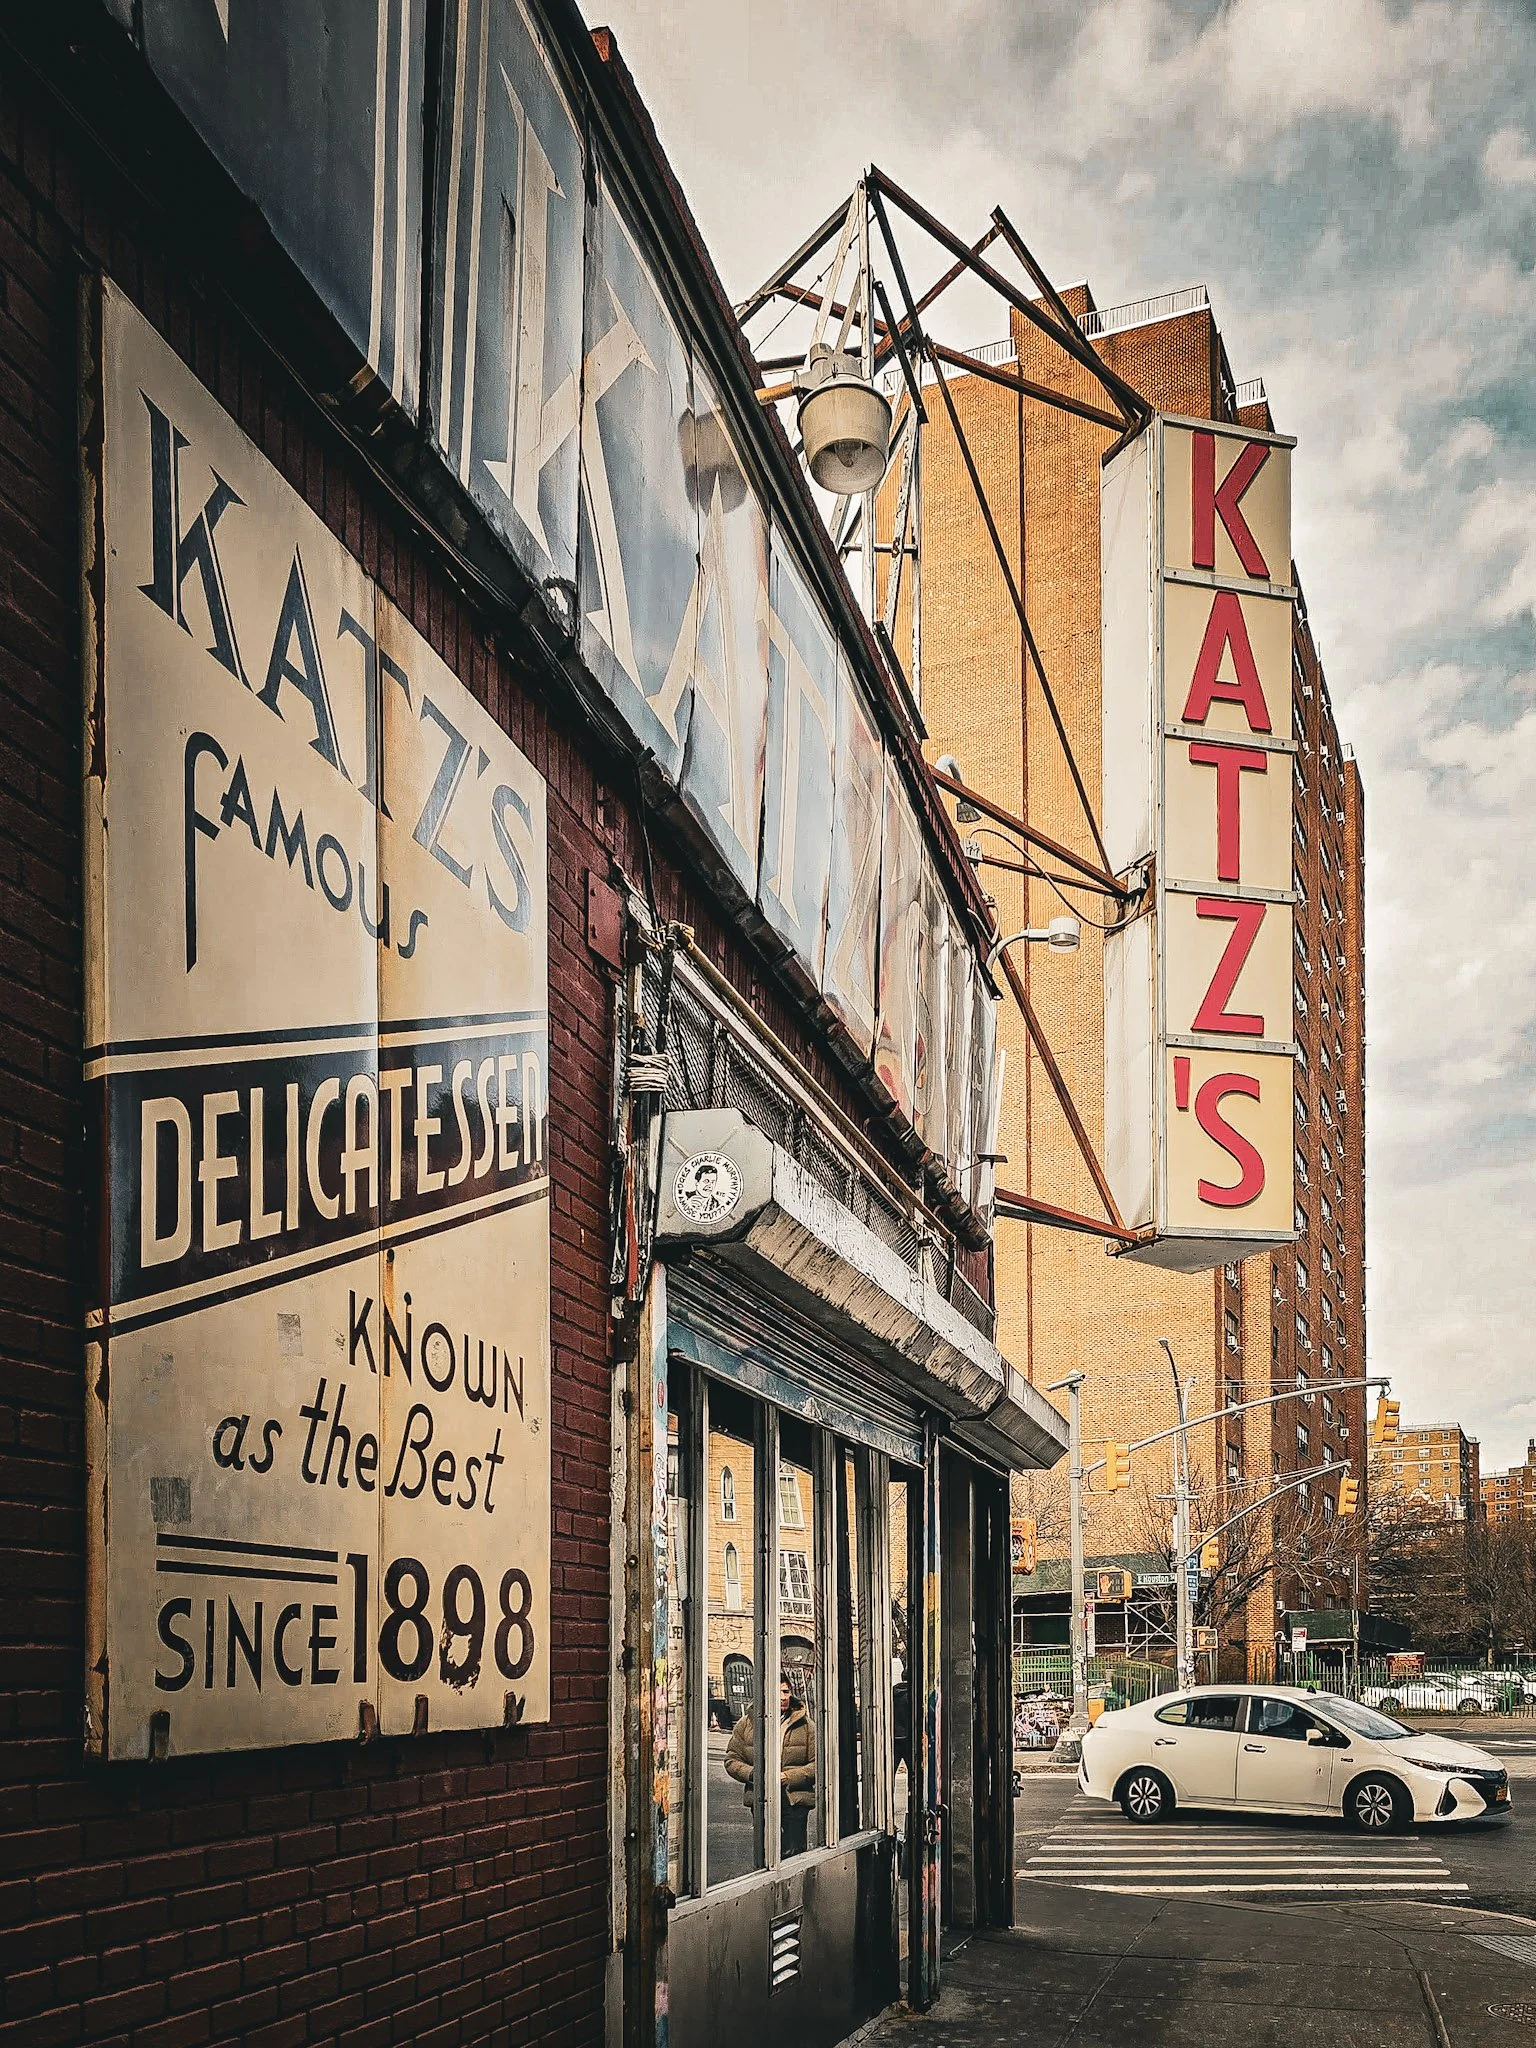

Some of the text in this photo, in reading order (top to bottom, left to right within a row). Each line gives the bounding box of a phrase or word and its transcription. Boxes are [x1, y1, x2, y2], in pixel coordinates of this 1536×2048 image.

[137, 388, 533, 933] KATZ'S
[1174, 429, 1271, 1208] KATZ'S
[141, 1050, 543, 1268] DELICATESSEN
[678, 1196, 697, 1218] AMUSE
[691, 1155, 722, 1168] CHARLIE
[348, 1289, 526, 1422] KNOWN
[213, 1377, 505, 1514] as the Best
[155, 1552, 535, 1694] SINCE 1898
